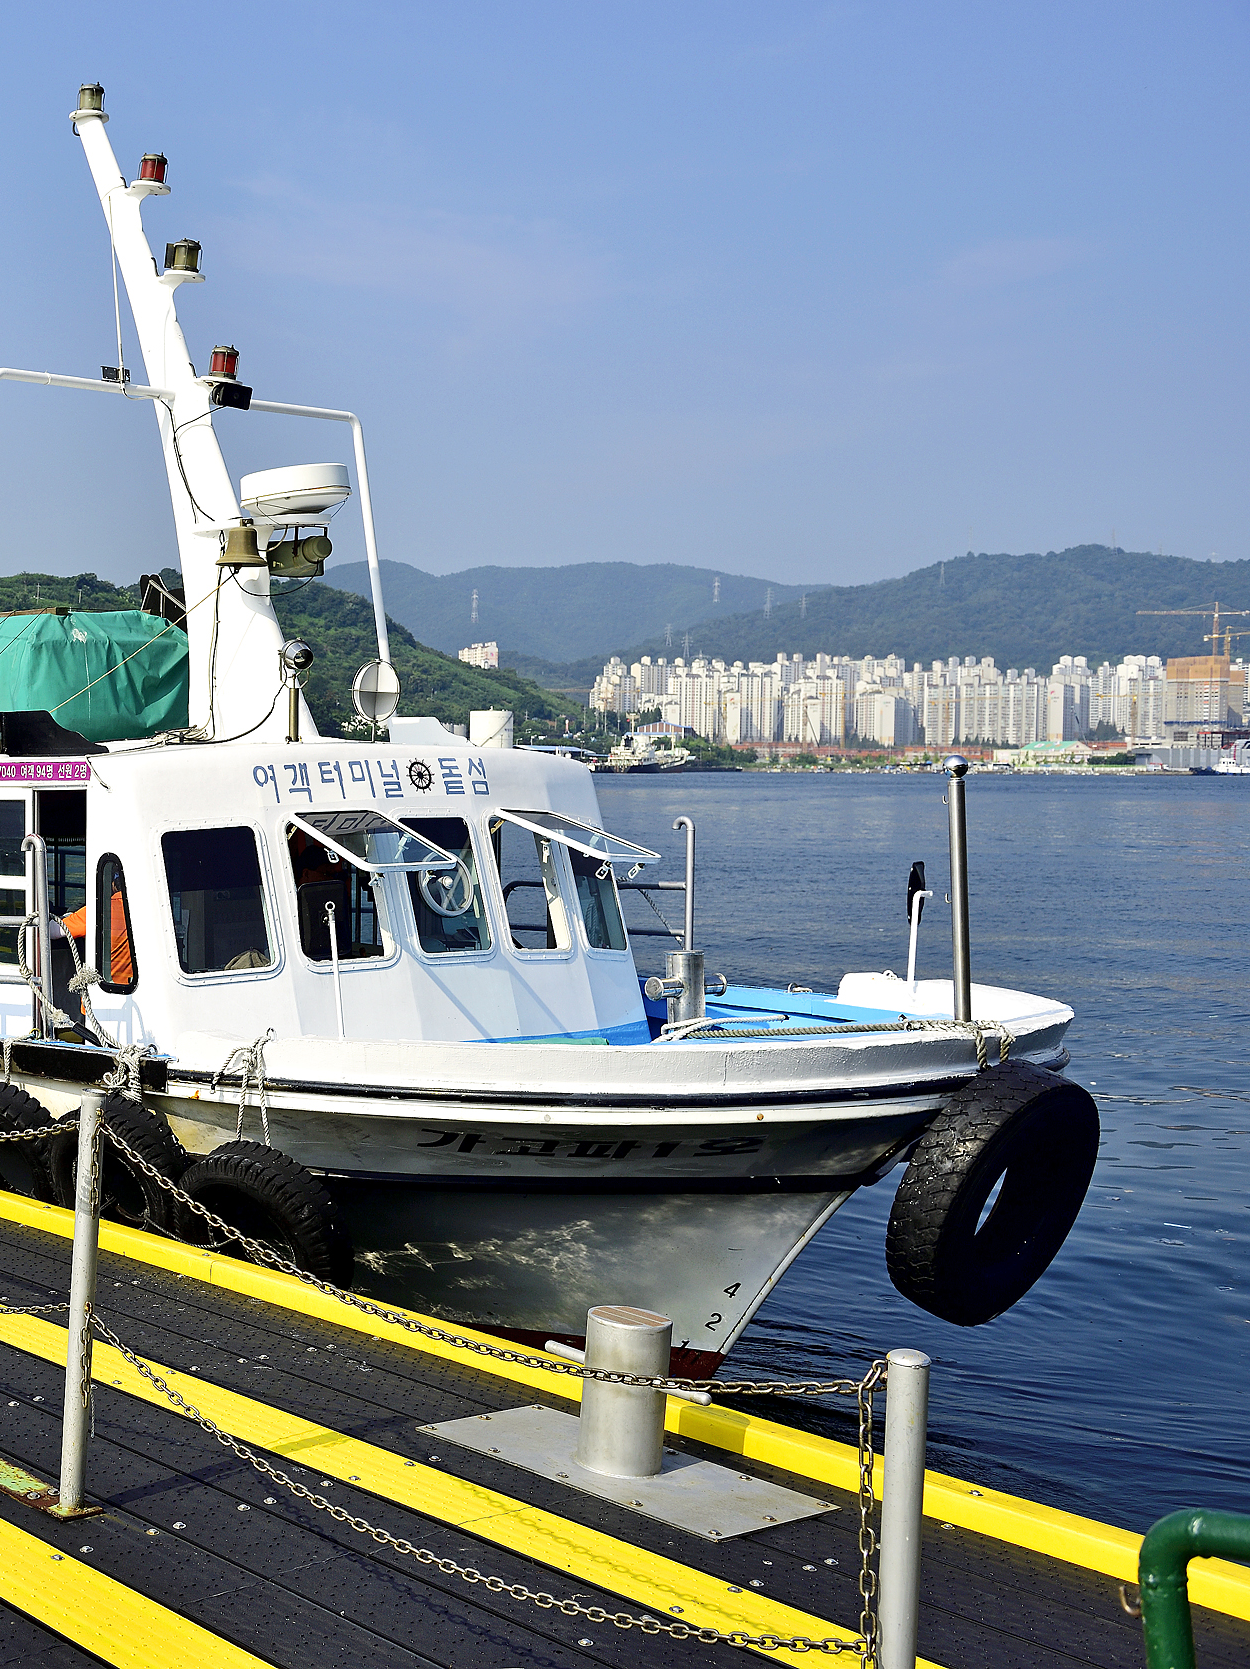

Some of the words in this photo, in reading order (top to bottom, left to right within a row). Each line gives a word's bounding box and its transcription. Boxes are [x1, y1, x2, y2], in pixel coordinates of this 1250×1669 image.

[20, 764, 35, 779] 여객
[36, 764, 54, 779] 94명
[57, 763, 72, 779] 선원
[74, 763, 88, 779] 2명
[437, 757, 490, 796] 돝섬
[722, 1281, 742, 1299] 4
[704, 1312, 722, 1332] 2
